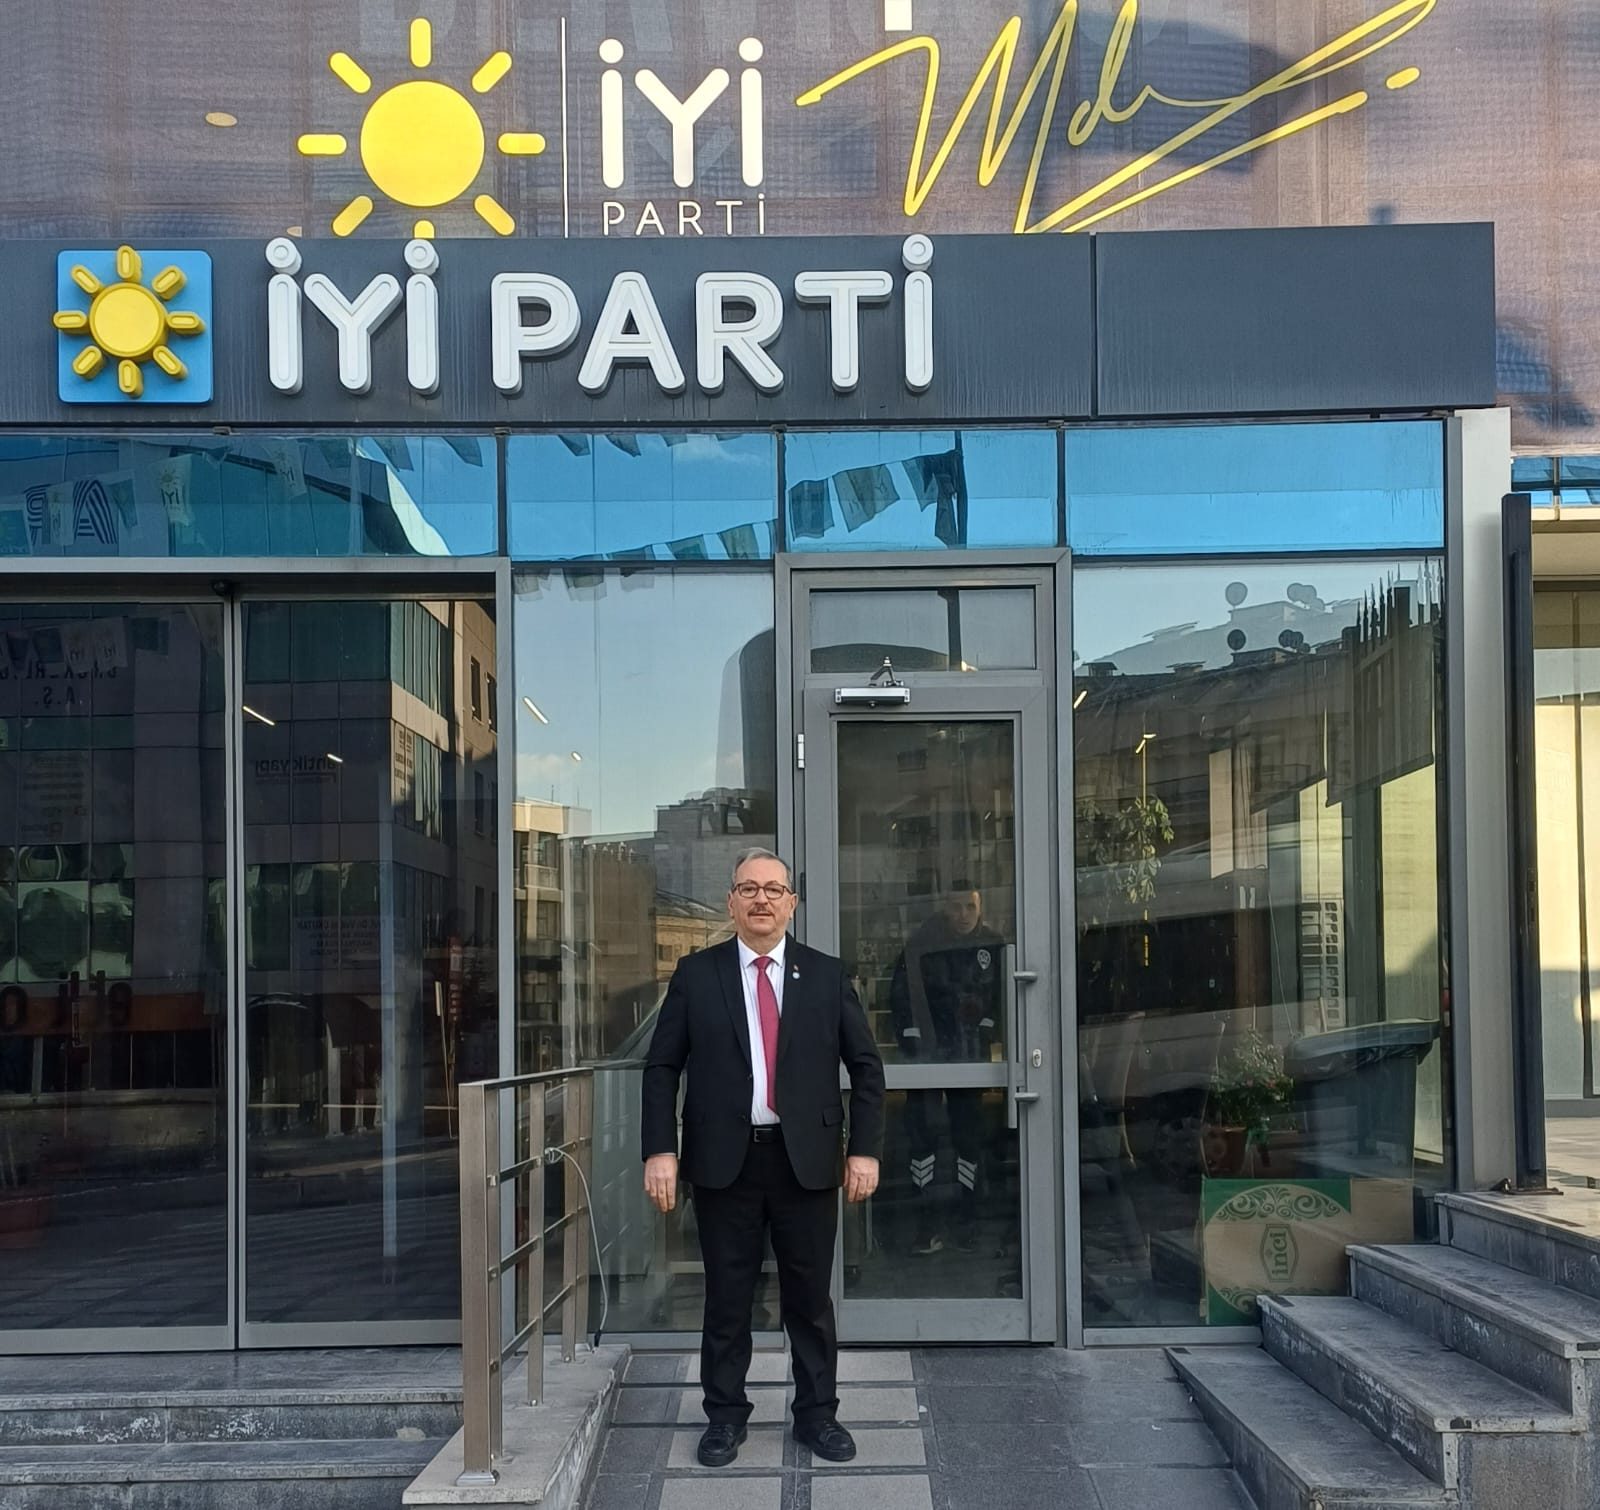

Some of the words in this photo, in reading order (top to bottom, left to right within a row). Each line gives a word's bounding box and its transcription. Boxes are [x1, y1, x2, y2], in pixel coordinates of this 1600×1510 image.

[598, 37, 764, 189] İYİ
[603, 193, 766, 236] PARTİ
[265, 237, 441, 393] İYİ
[490, 234, 935, 393] PARTİ
